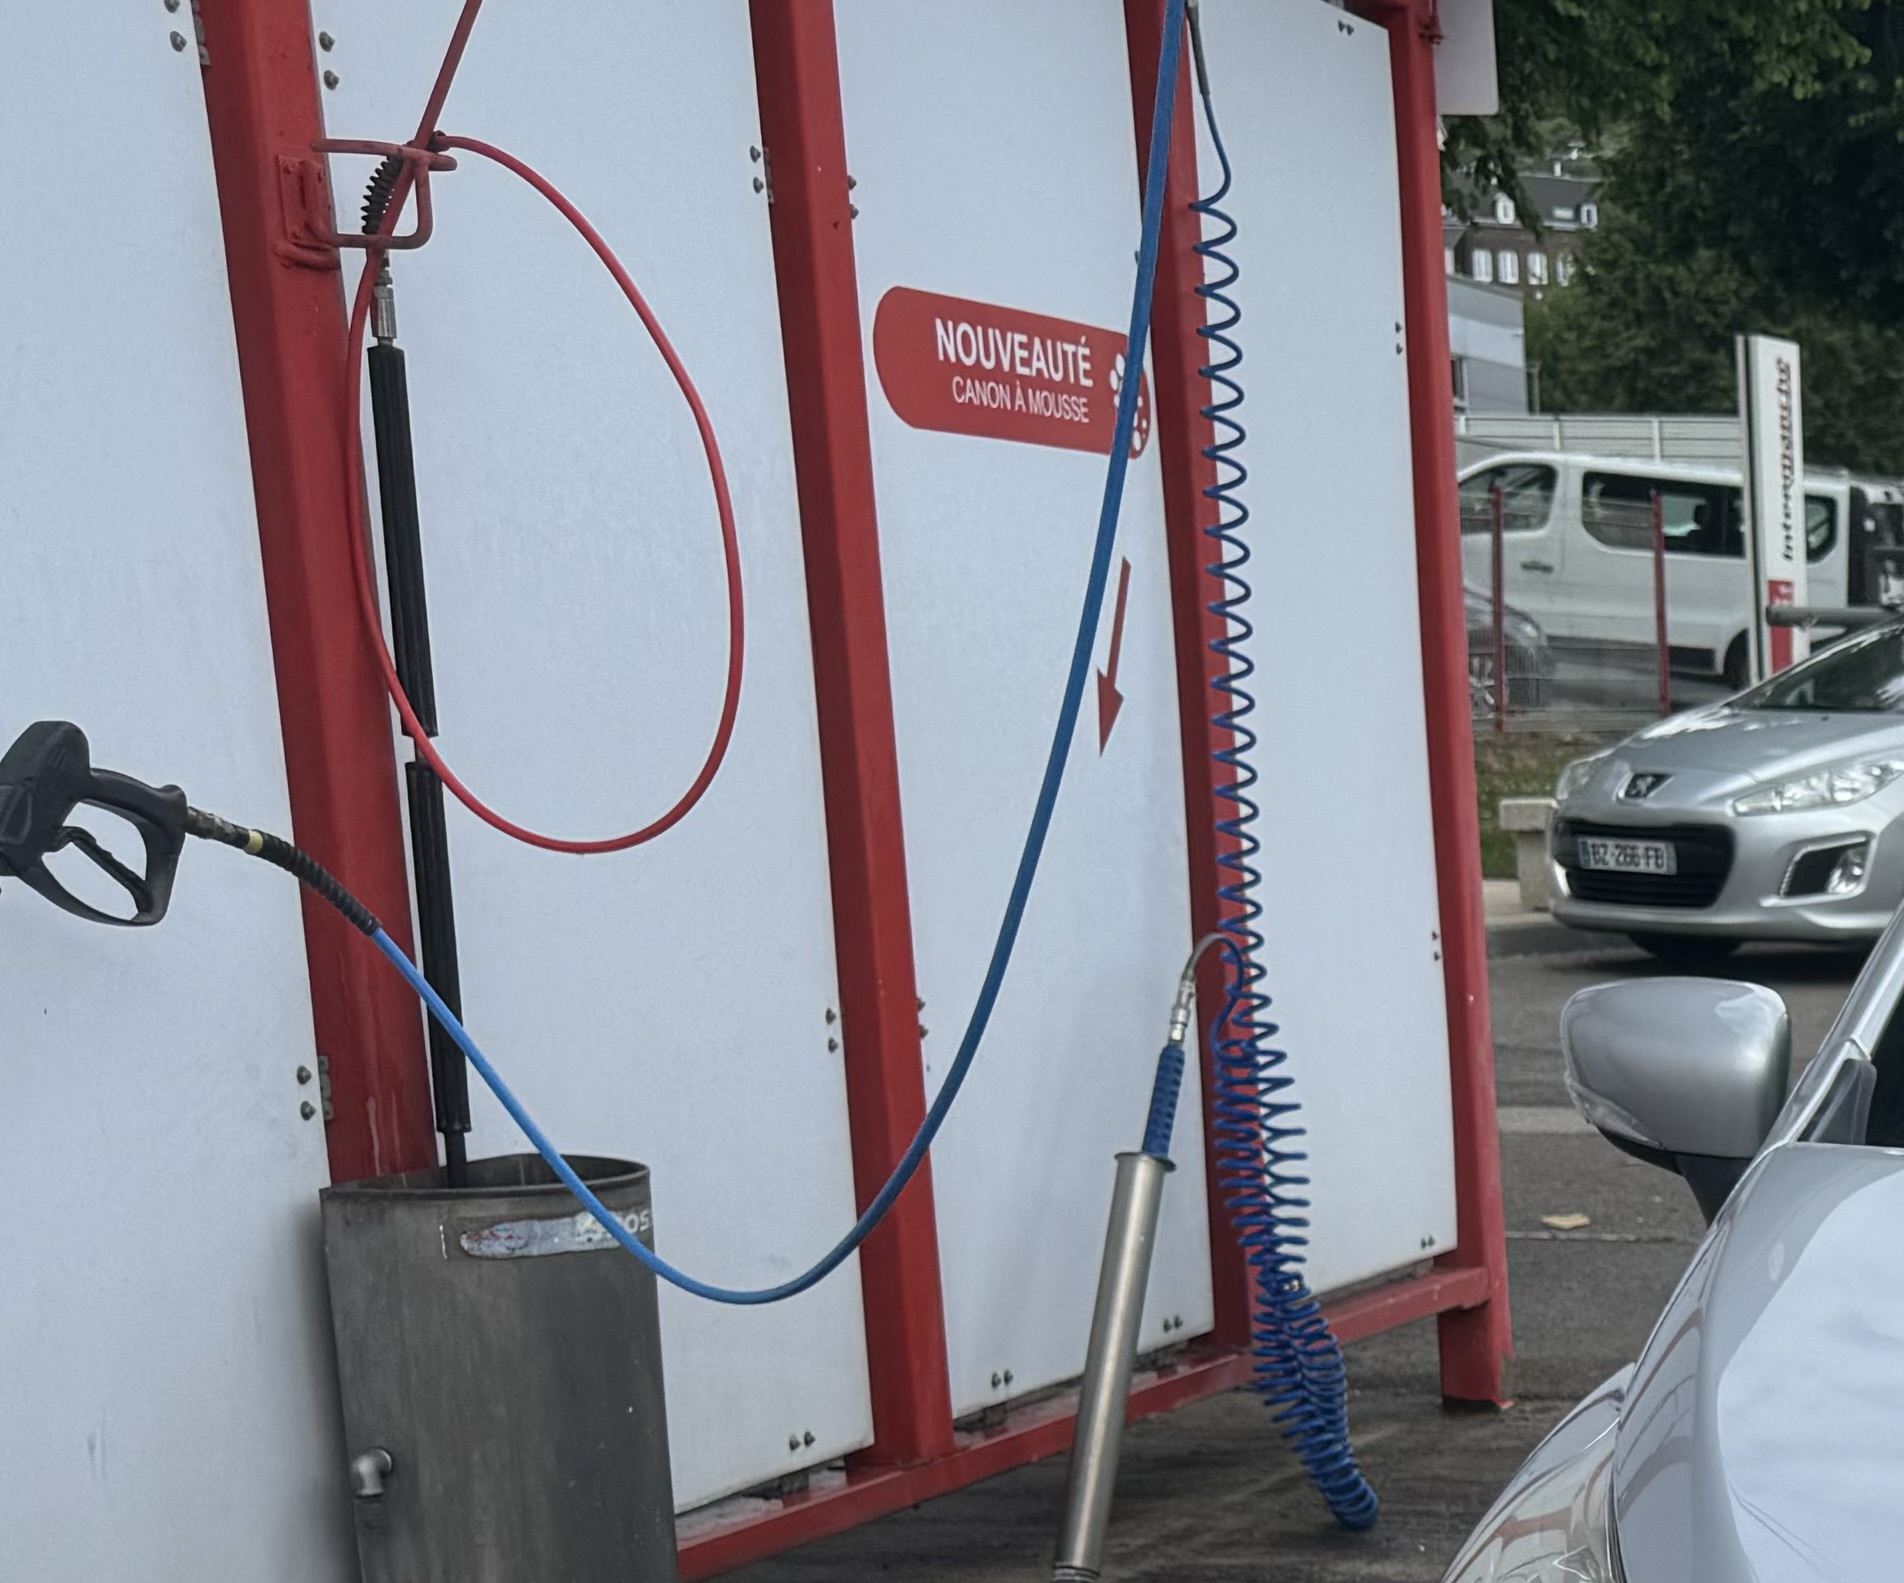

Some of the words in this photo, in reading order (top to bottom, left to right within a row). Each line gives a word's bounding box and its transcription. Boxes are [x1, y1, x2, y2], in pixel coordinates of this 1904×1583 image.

[935, 318, 1094, 388] NOUVEAUTÉ
[952, 376, 1012, 411] CANON
[1014, 380, 1026, 412] À
[1028, 388, 1090, 423] MOUSSE
